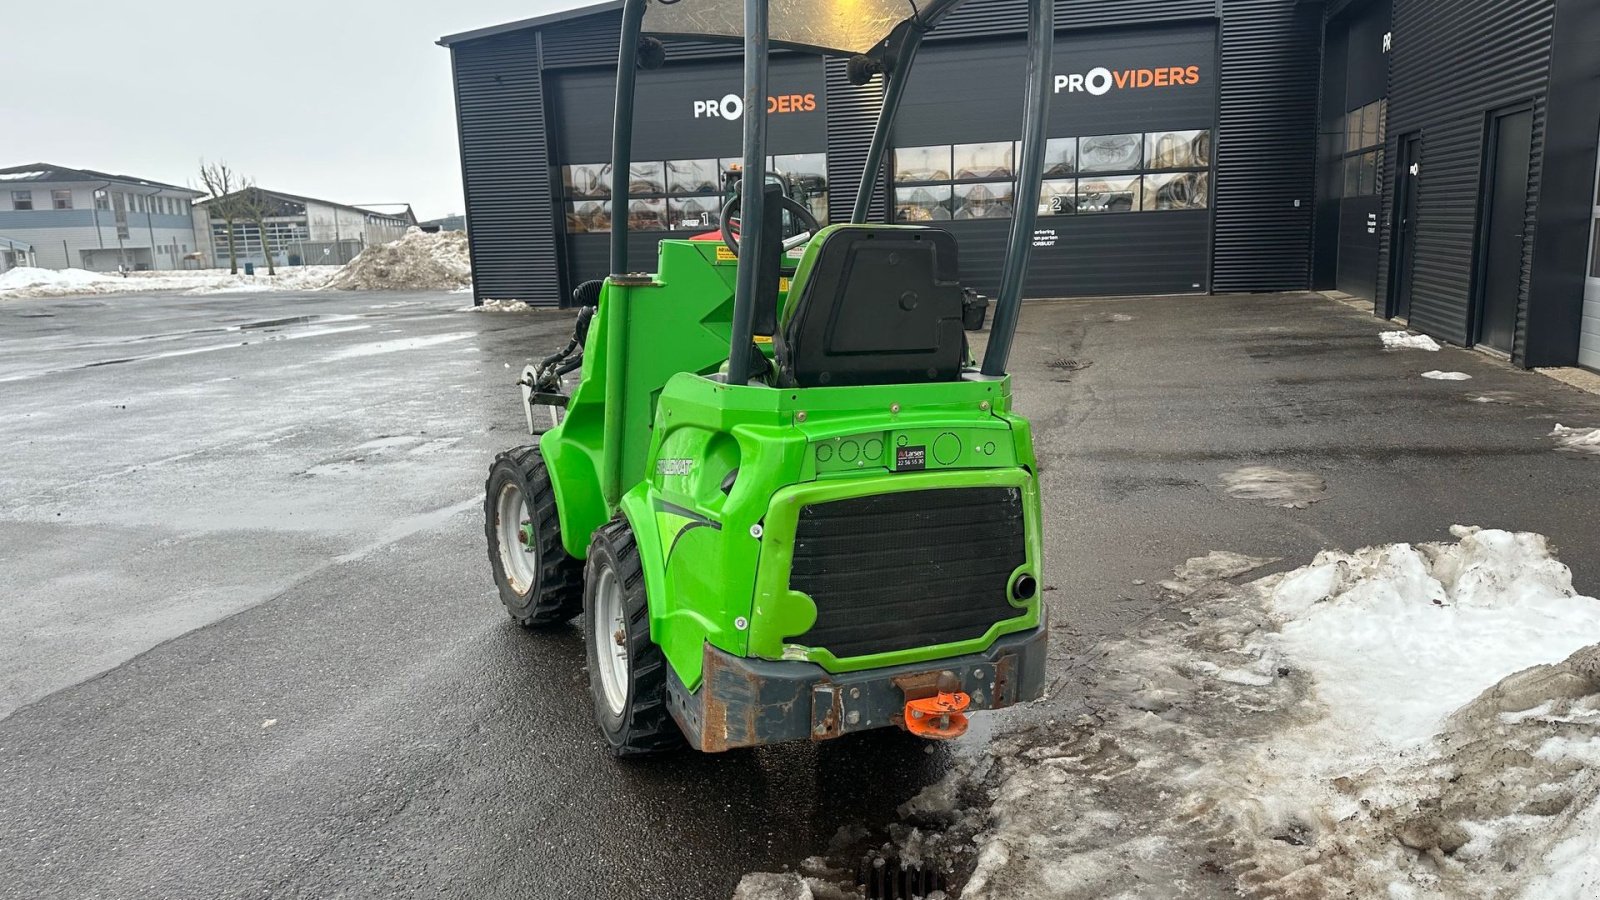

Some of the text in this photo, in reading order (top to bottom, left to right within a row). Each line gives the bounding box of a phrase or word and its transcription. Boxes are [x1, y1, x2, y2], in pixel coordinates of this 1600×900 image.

[1054, 65, 1200, 96] PROVIDERS
[694, 94, 816, 120] PRODERS
[1050, 197, 1062, 211] 2
[701, 211, 709, 226] 1
